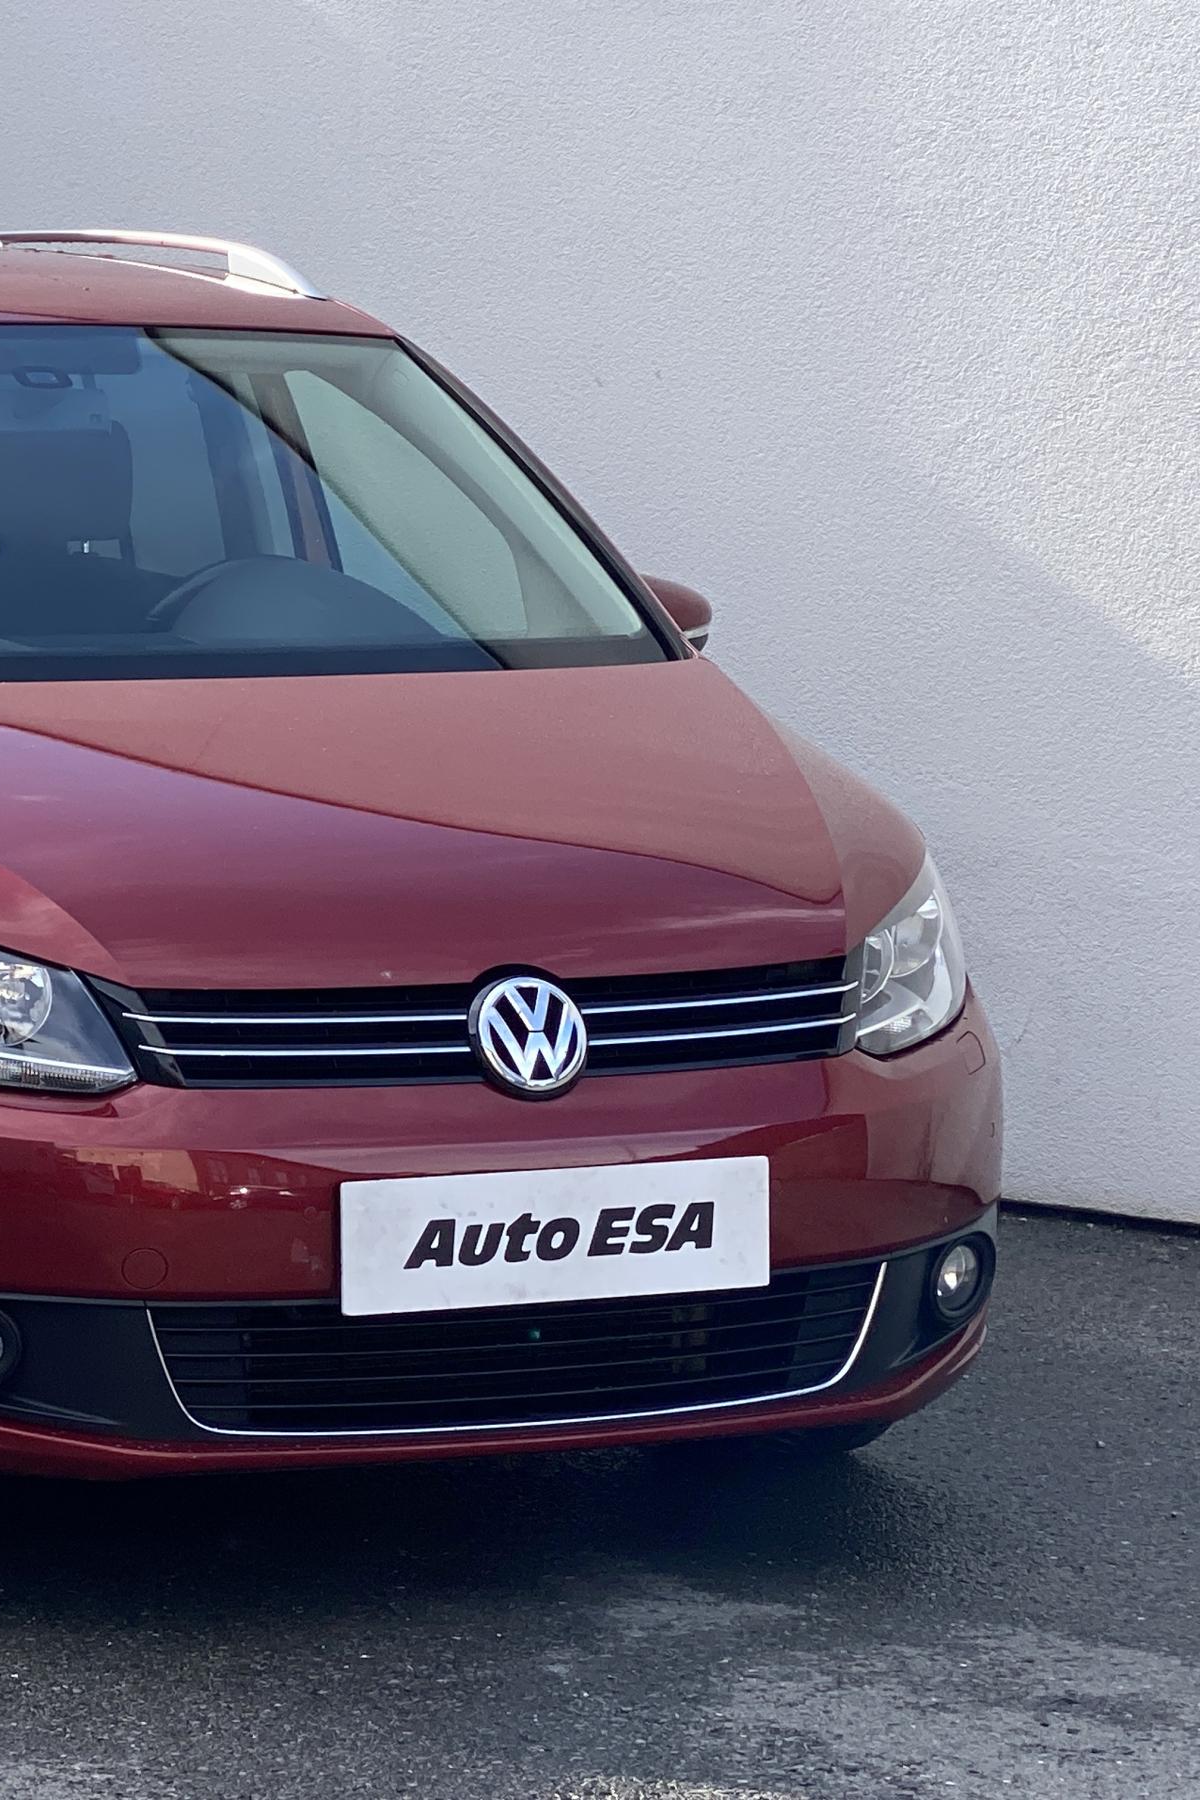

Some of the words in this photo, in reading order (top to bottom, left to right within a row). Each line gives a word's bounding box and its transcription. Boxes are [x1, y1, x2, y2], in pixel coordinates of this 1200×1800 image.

[479, 977, 588, 1090] VW
[403, 1212, 580, 1270] Auto
[586, 1201, 715, 1257] ESA
